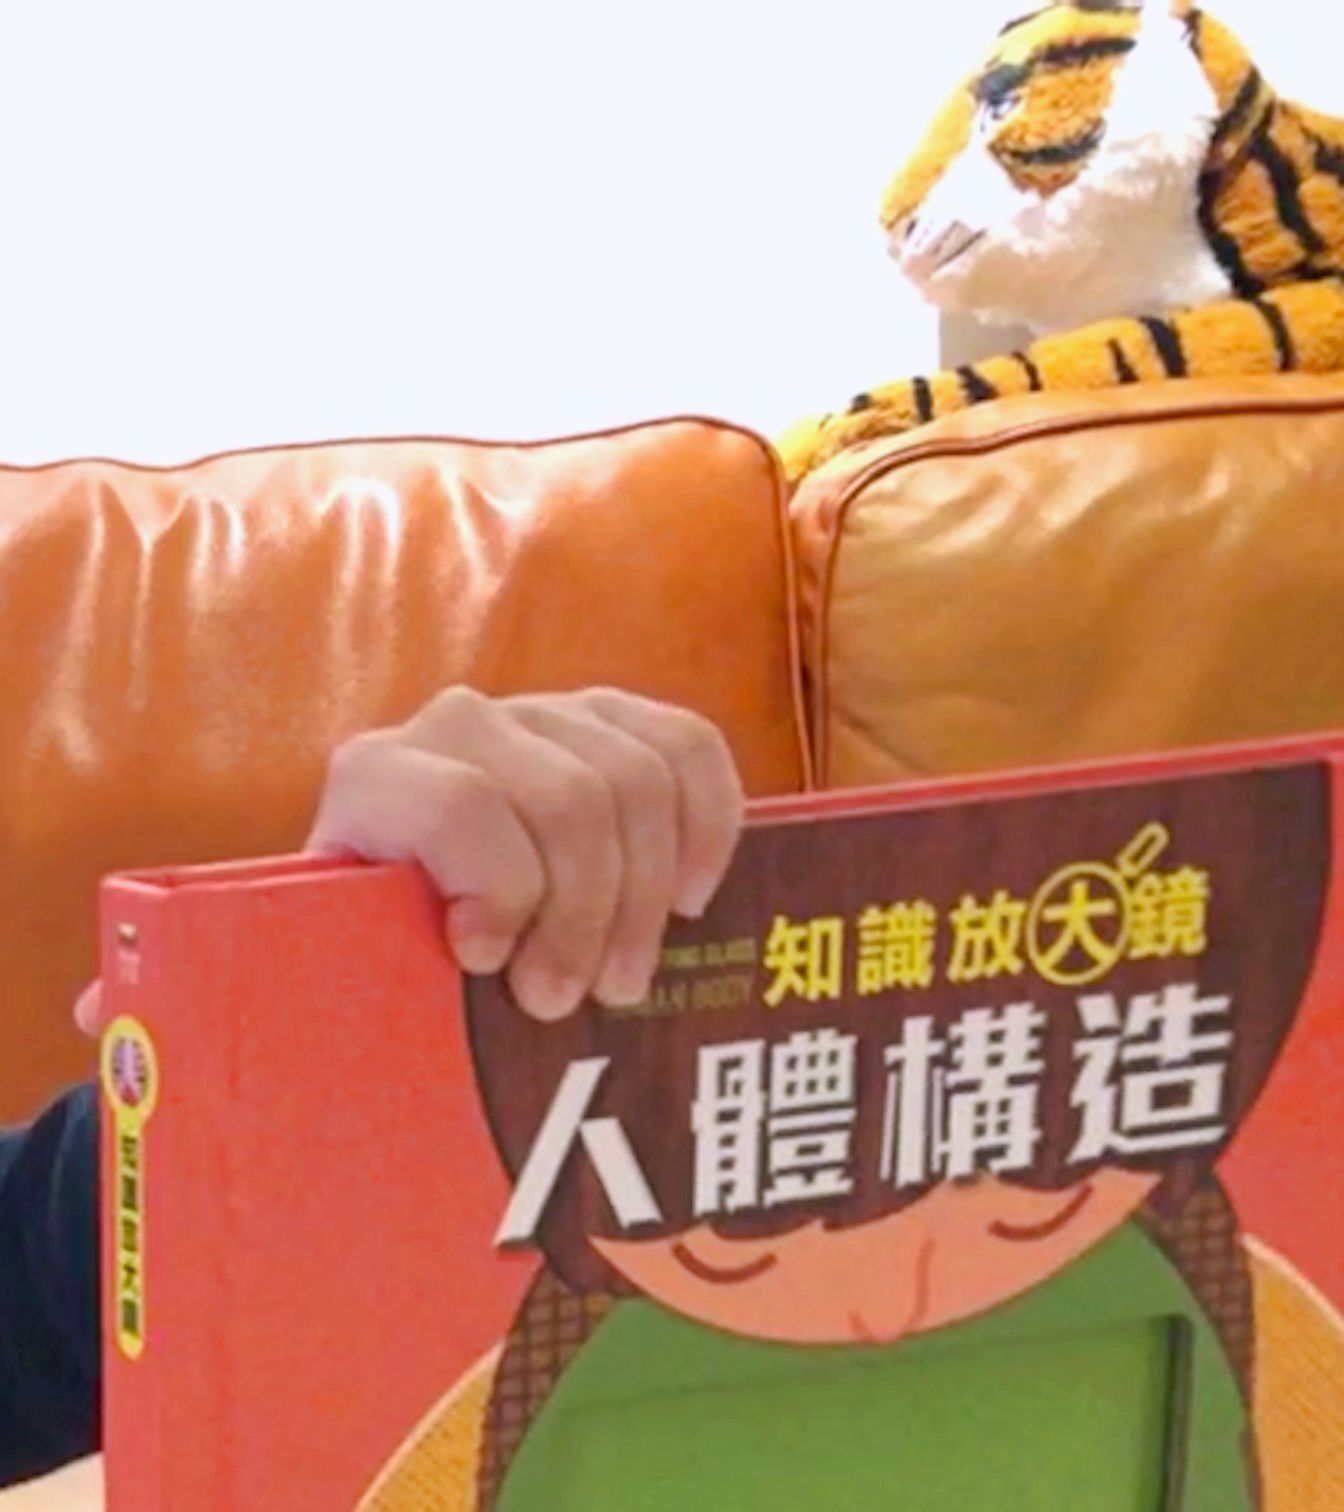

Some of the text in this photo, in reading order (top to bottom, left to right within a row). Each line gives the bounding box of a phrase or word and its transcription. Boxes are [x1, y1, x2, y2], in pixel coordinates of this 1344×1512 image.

[763, 858, 1212, 1006] 知識放大鏡
[492, 981, 1236, 1250] 人體構造
